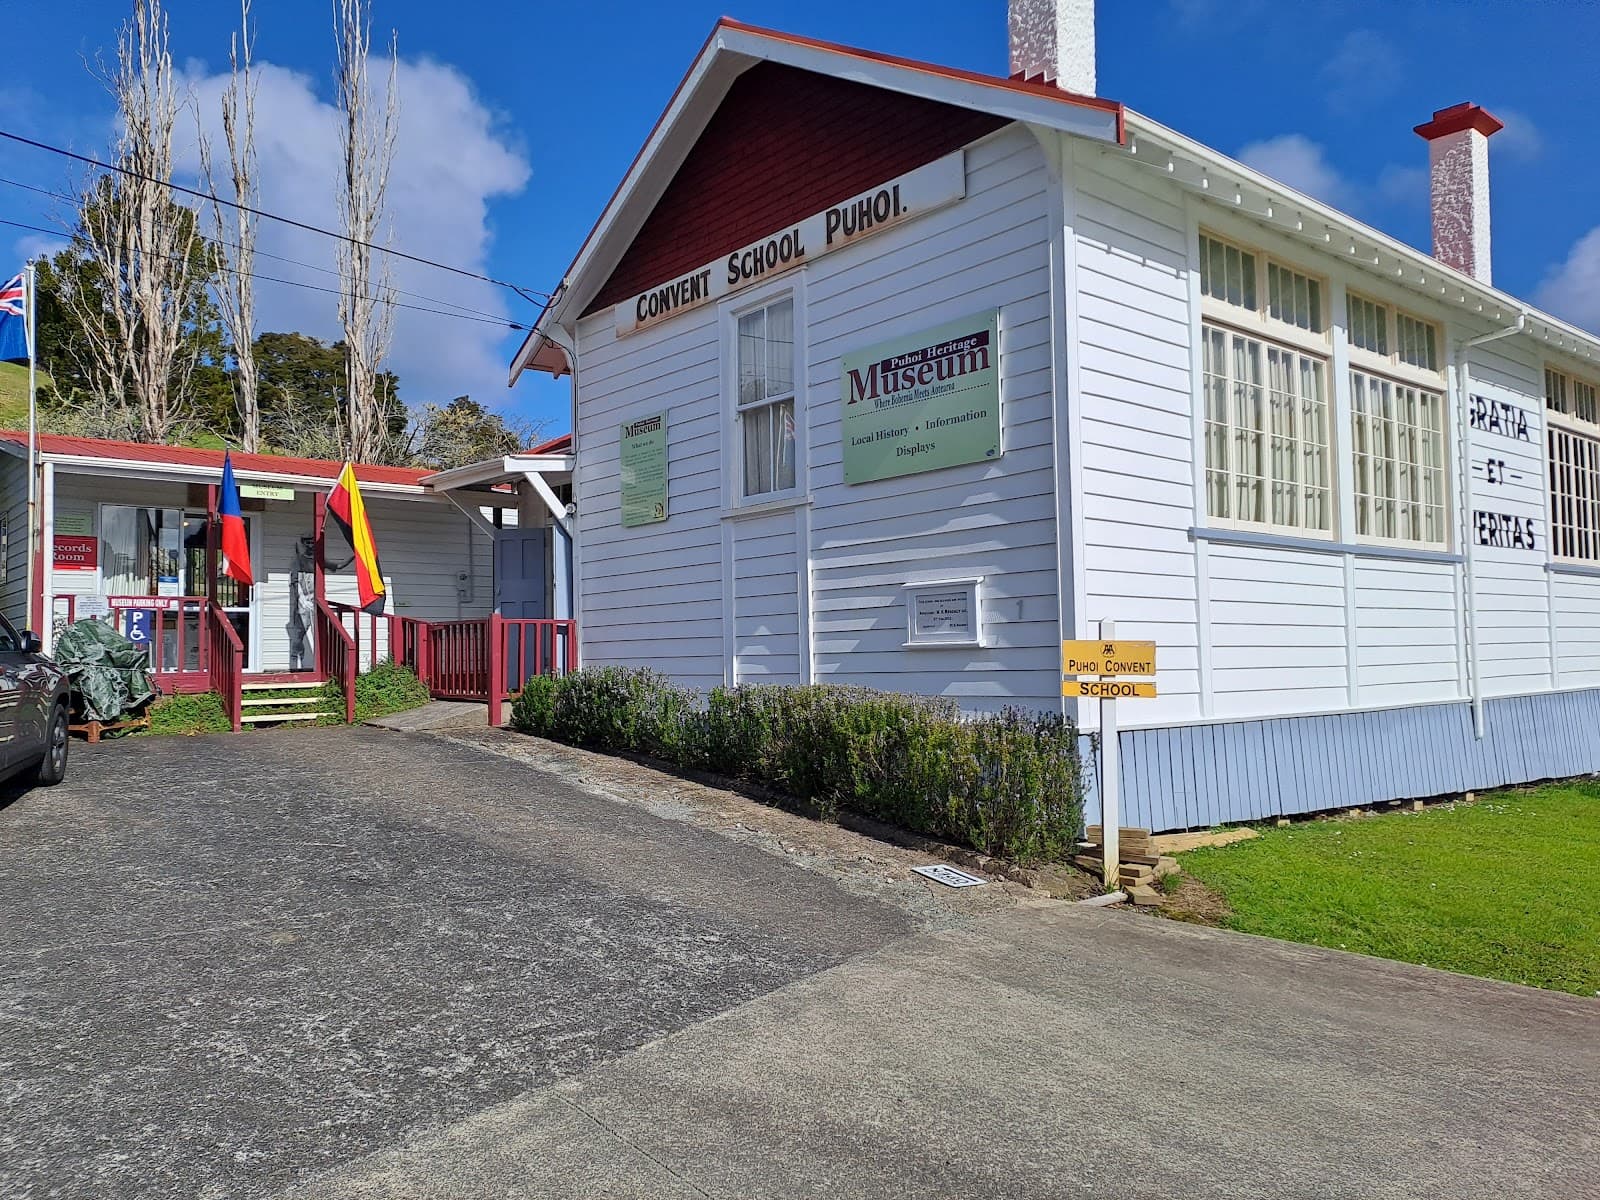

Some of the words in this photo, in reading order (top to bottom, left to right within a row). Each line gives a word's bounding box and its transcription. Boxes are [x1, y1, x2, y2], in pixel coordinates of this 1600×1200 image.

[636, 269, 711, 322] CONVENT
[727, 228, 805, 285] SCHOOL
[825, 184, 908, 244] PUHOI.
[891, 351, 922, 369] Puhoi
[926, 336, 977, 359] Heritage
[847, 346, 991, 405] Museum
[874, 398, 891, 409] Where
[891, 391, 913, 406] Bohemia
[914, 387, 930, 400] Meets
[625, 422, 661, 439] Museum
[851, 431, 874, 446] Local
[876, 426, 909, 442] History
[925, 409, 987, 430] Information
[896, 442, 936, 457] Displays
[53, 543, 92, 553] ecords
[133, 599, 154, 608] PARKING
[155, 600, 168, 608] ONLY
[1069, 659, 1099, 672] PUHOI
[1105, 660, 1151, 673] CONVENT
[1080, 682, 1140, 697] SCHOOL
